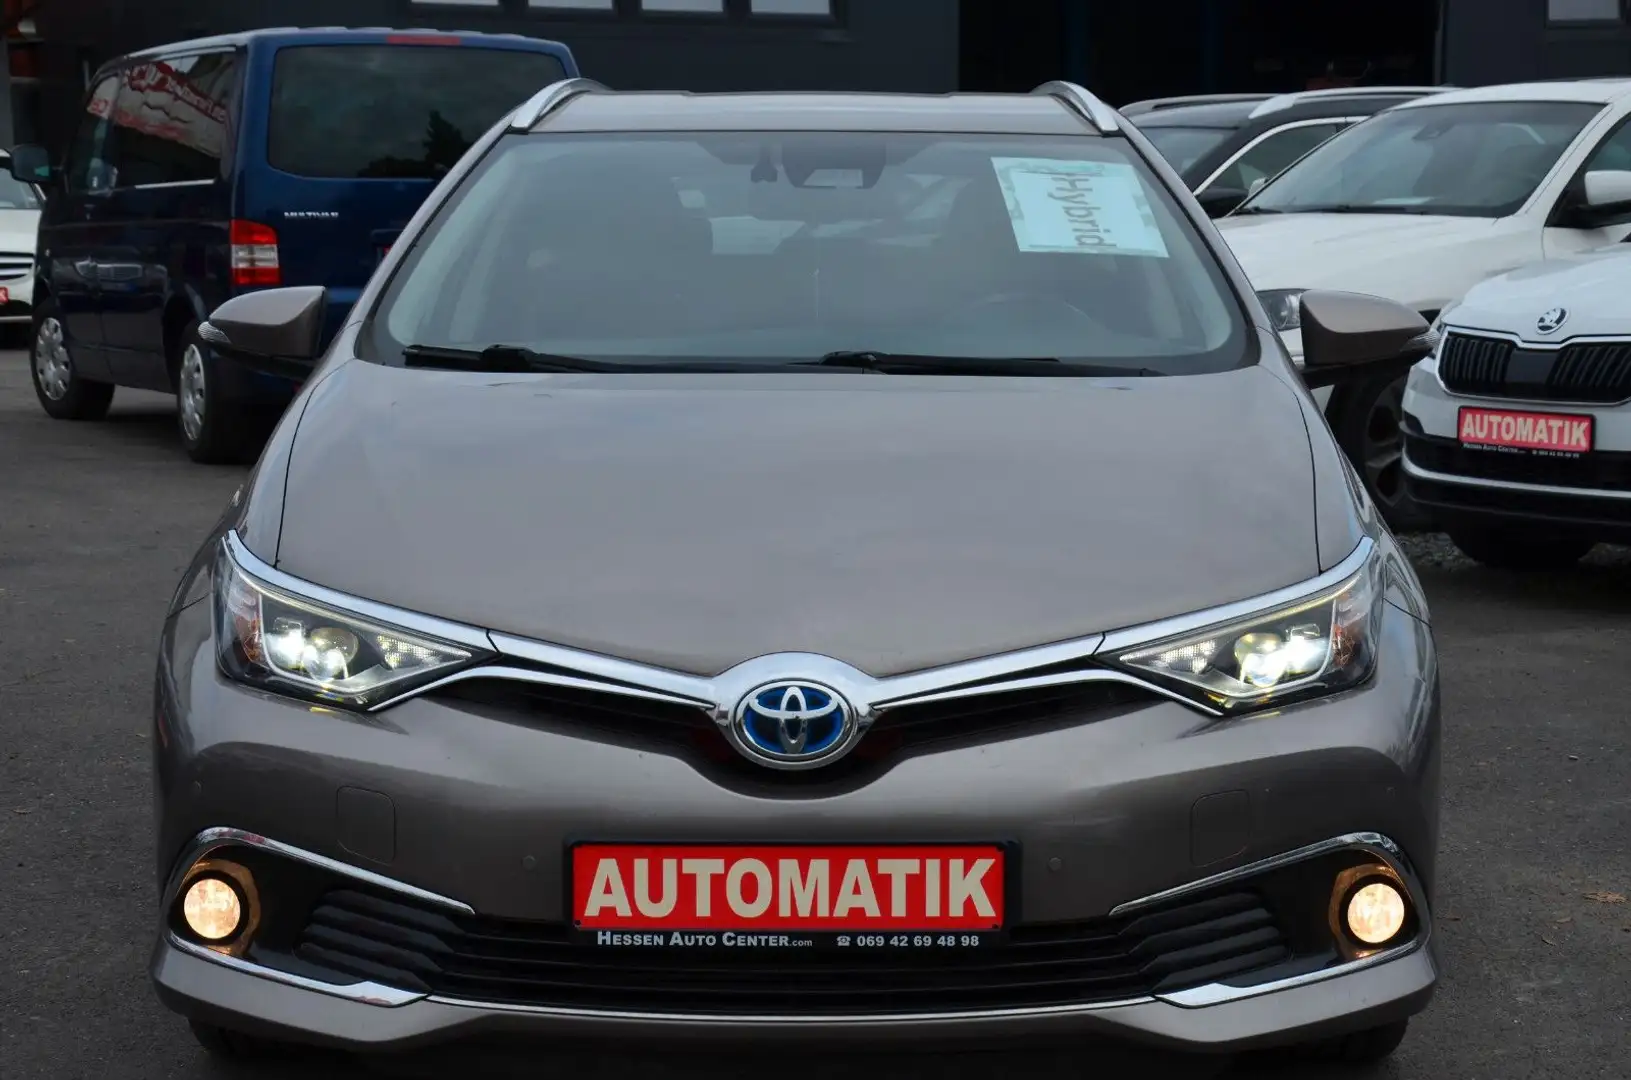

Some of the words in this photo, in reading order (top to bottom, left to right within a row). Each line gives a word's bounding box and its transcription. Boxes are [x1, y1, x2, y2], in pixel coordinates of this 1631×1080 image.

[1047, 176, 1118, 247] Hybrid
[1462, 412, 1590, 448] AUTOMATIK
[584, 857, 997, 919] AUTOMATIK
[597, 931, 664, 946] HESSEN
[669, 931, 717, 947] AUTO
[856, 935, 885, 947] 069
[889, 935, 909, 947] 42
[913, 935, 932, 947] 69
[936, 935, 956, 947] 48
[960, 935, 980, 947] 98
